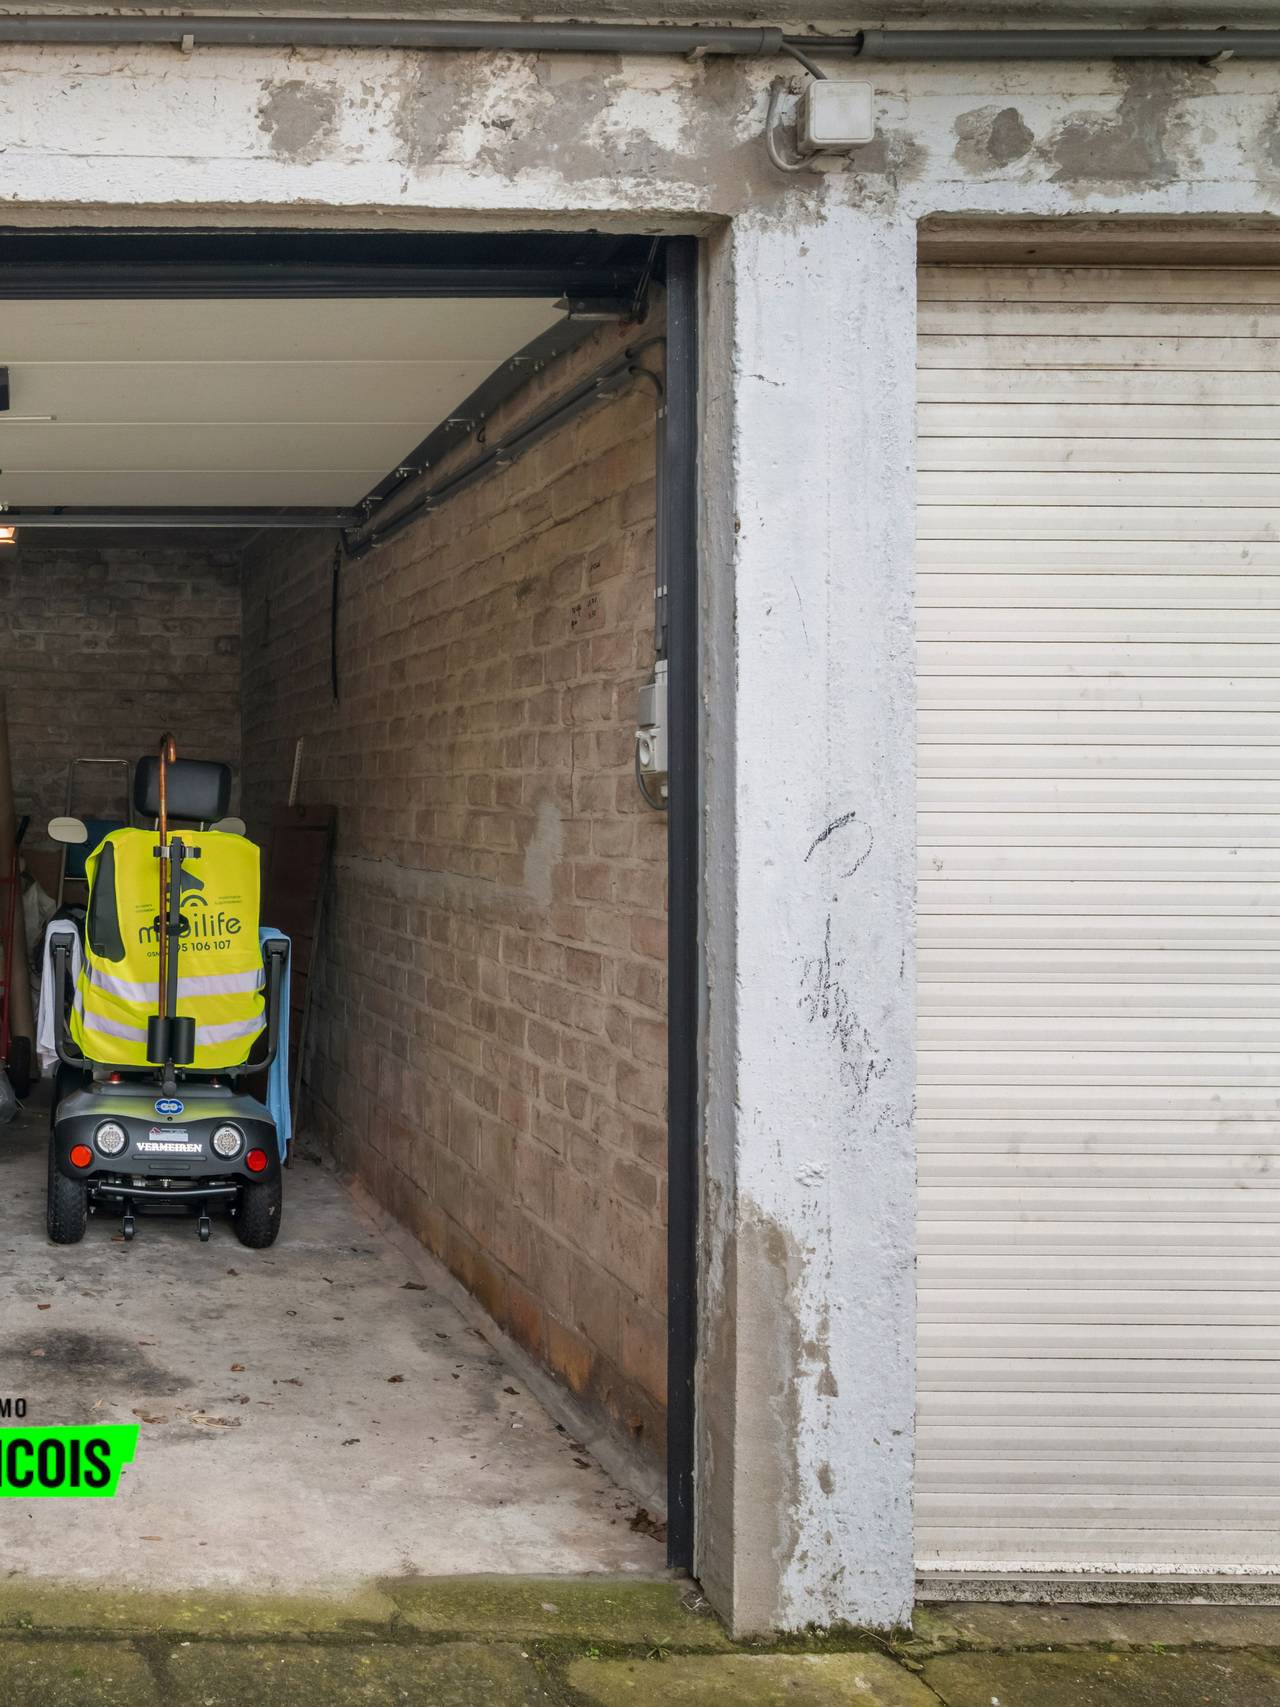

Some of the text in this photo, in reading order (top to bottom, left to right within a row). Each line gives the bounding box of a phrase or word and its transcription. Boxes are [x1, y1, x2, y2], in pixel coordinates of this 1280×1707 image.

[138, 911, 242, 944] milife
[191, 941, 211, 952] 106
[214, 940, 231, 950] 107
[136, 1142, 203, 1152] VERMEIREN
